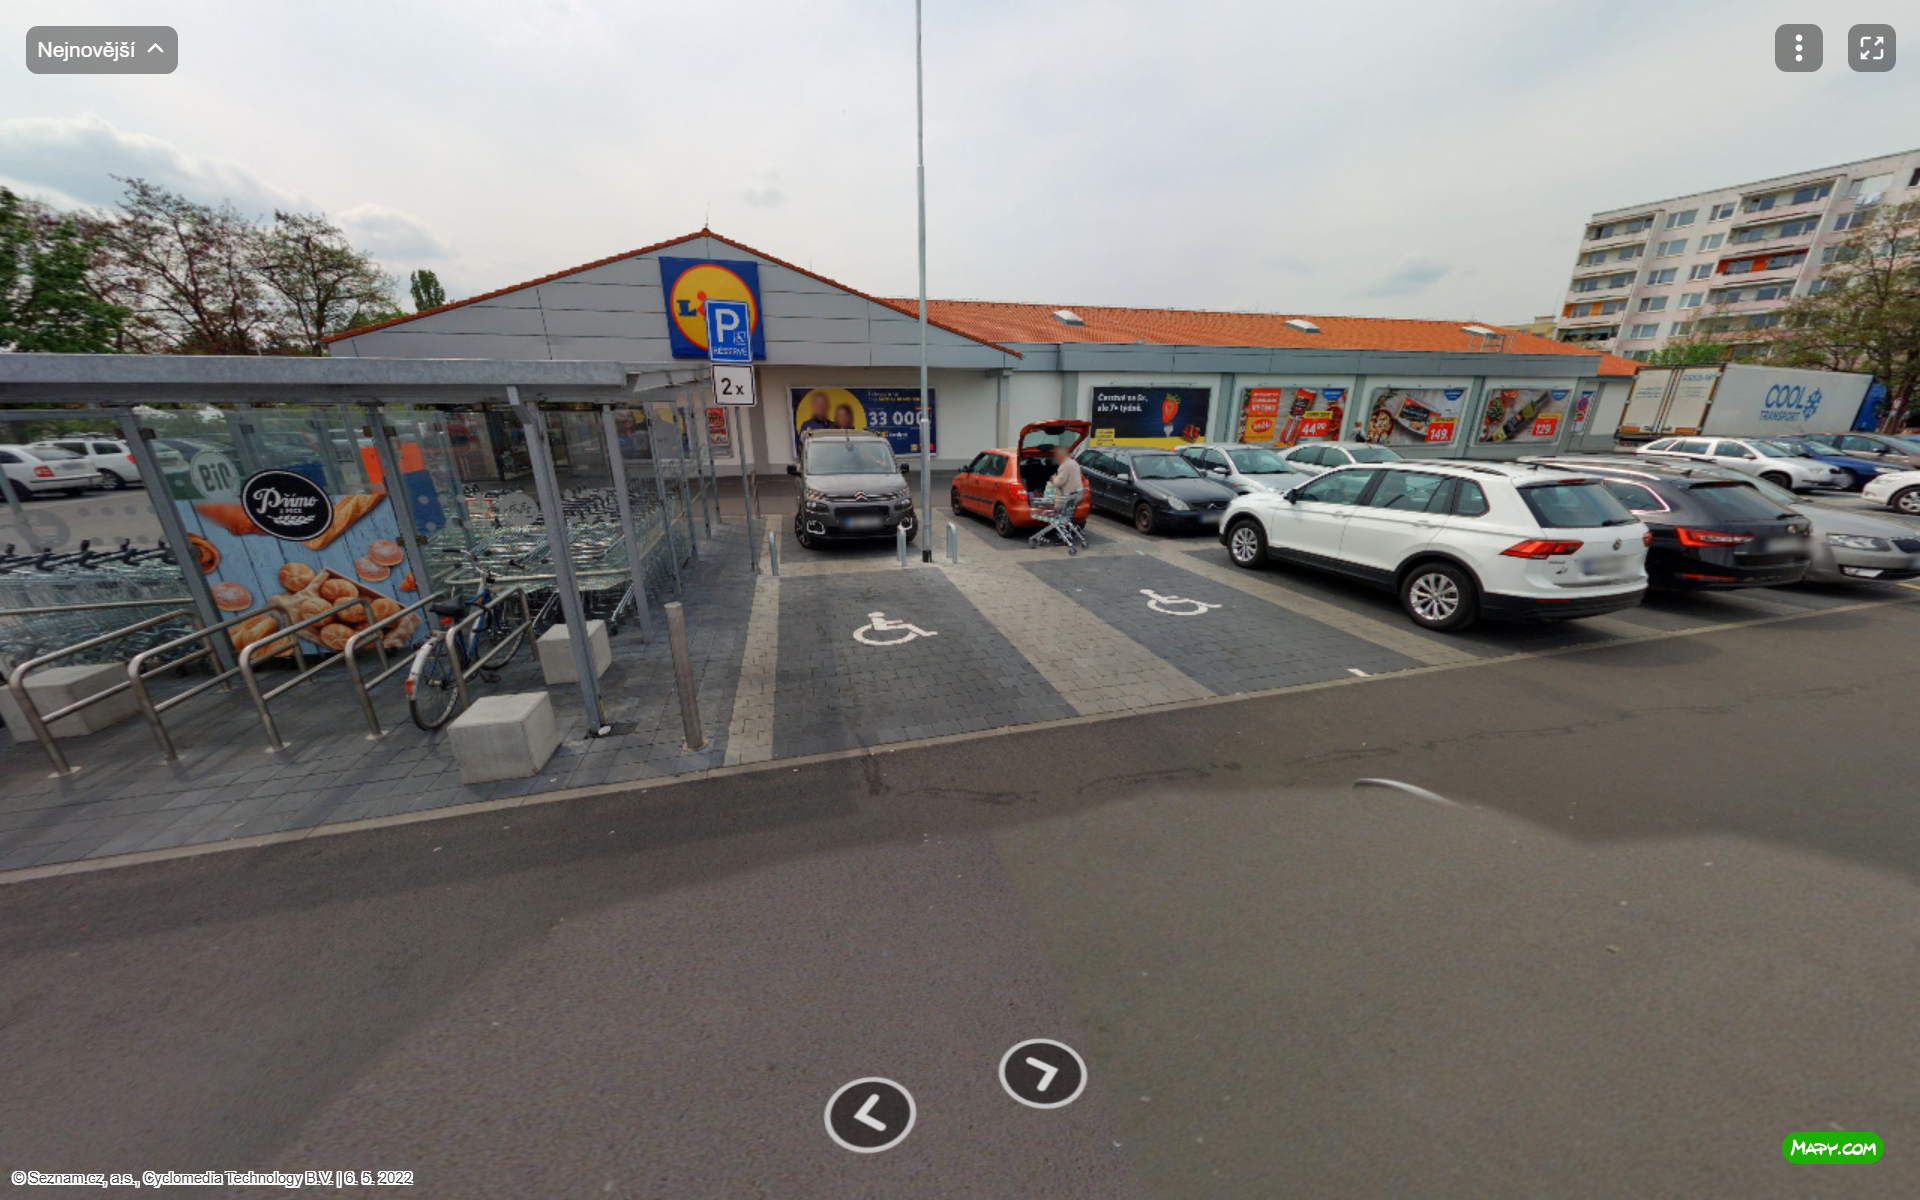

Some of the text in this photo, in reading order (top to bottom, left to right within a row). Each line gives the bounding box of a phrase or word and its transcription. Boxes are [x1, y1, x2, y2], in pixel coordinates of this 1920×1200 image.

[715, 308, 740, 343] P
[721, 377, 744, 395] 2 x
[1765, 384, 1806, 408] COOL
[868, 411, 887, 426] 33
[1759, 410, 1801, 422] TRANSPORT
